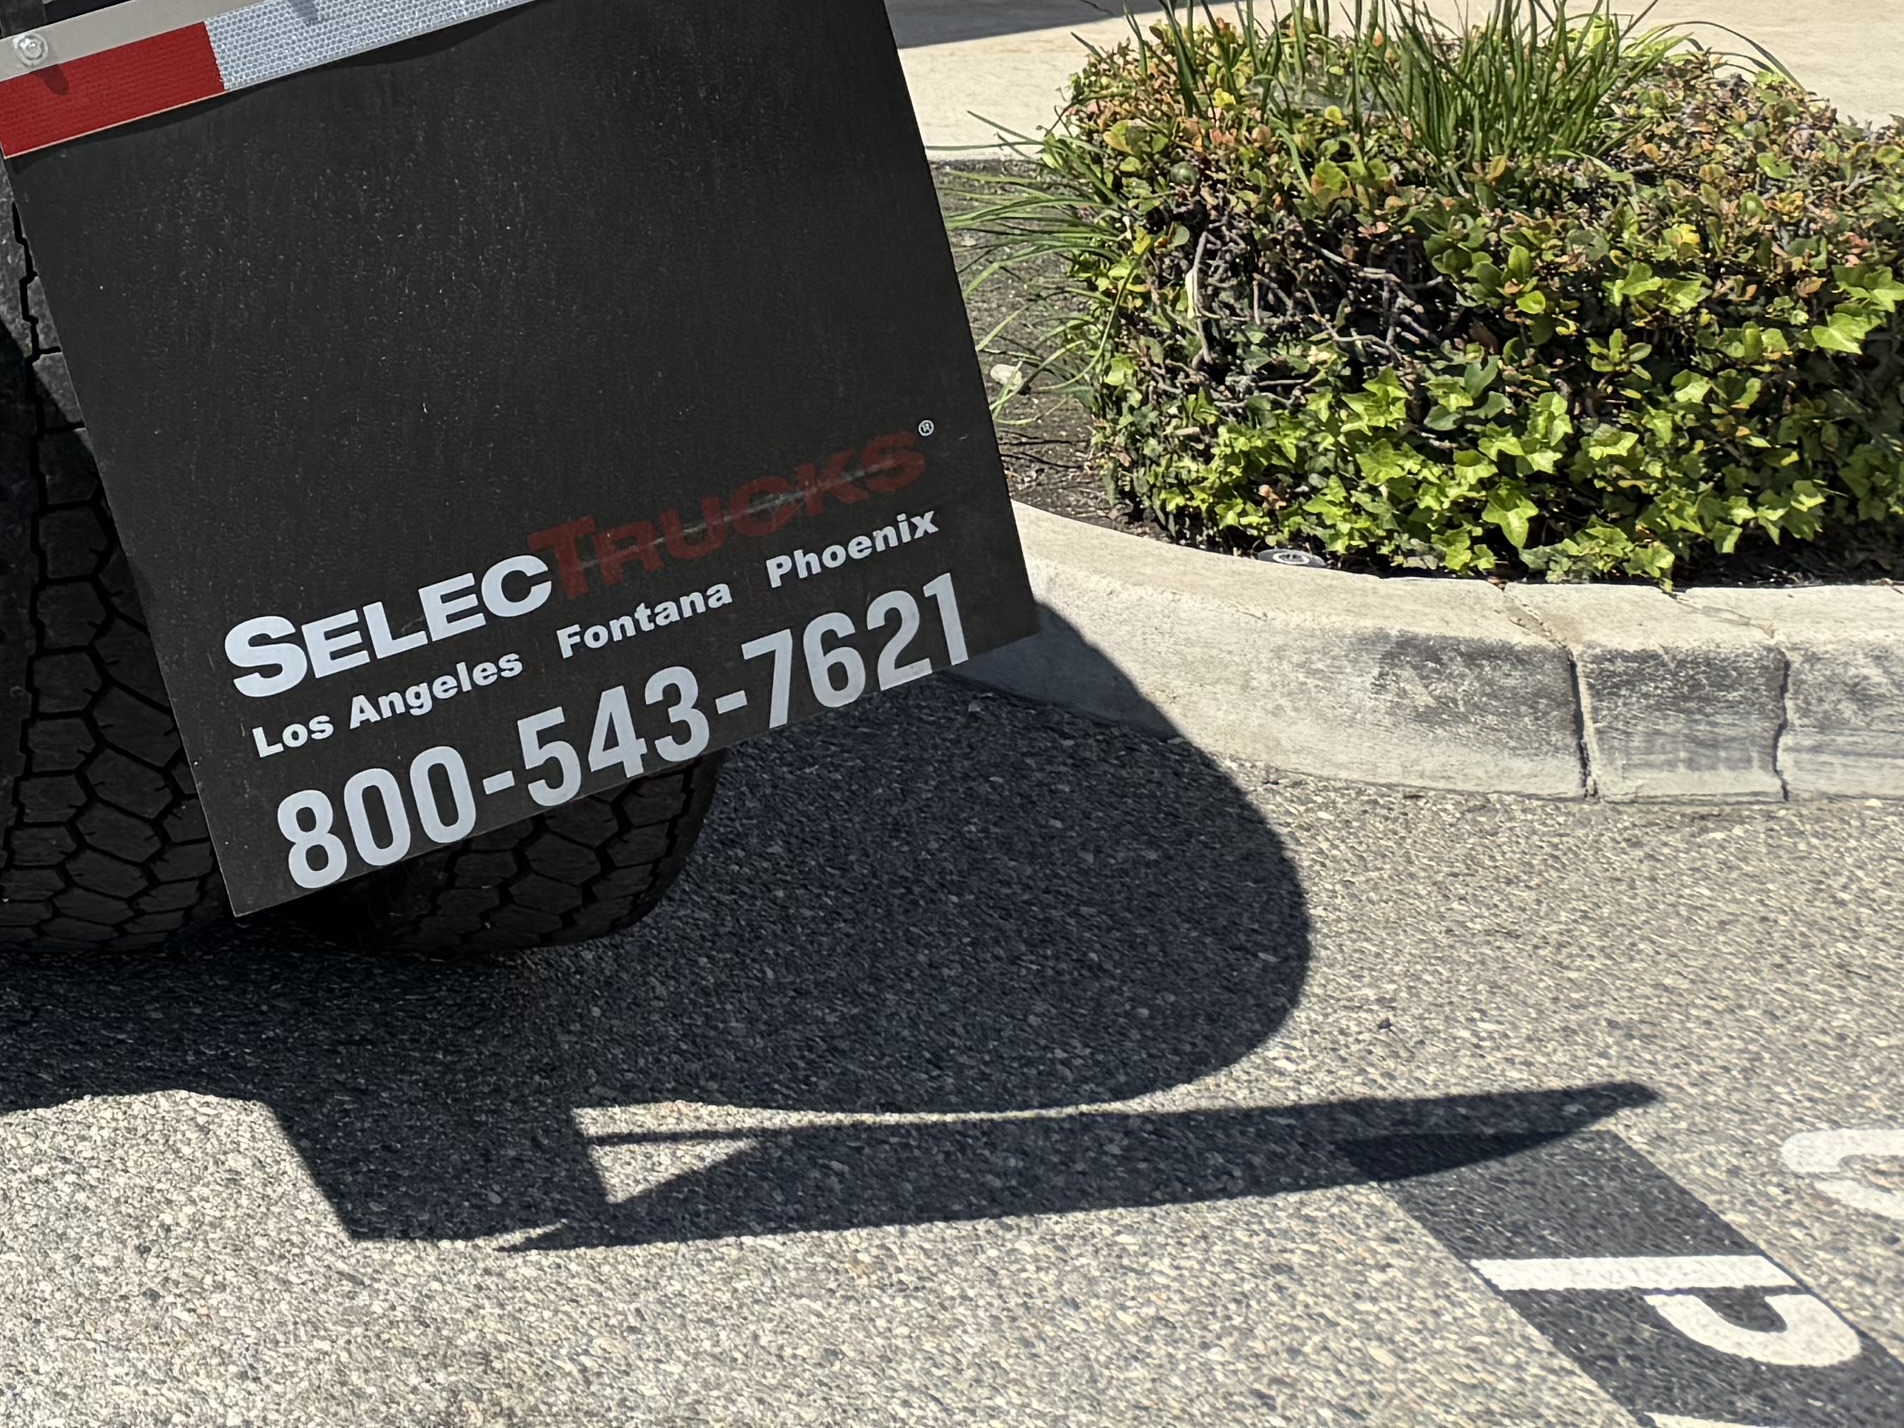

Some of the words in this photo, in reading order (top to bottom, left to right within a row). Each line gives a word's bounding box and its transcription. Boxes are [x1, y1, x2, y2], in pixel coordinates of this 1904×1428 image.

[252, 707, 334, 758] Los
[349, 649, 524, 728] Angeles
[556, 580, 734, 660] Fontana
[766, 506, 940, 589] Phoenix
[277, 572, 971, 891] 800-543-7621
